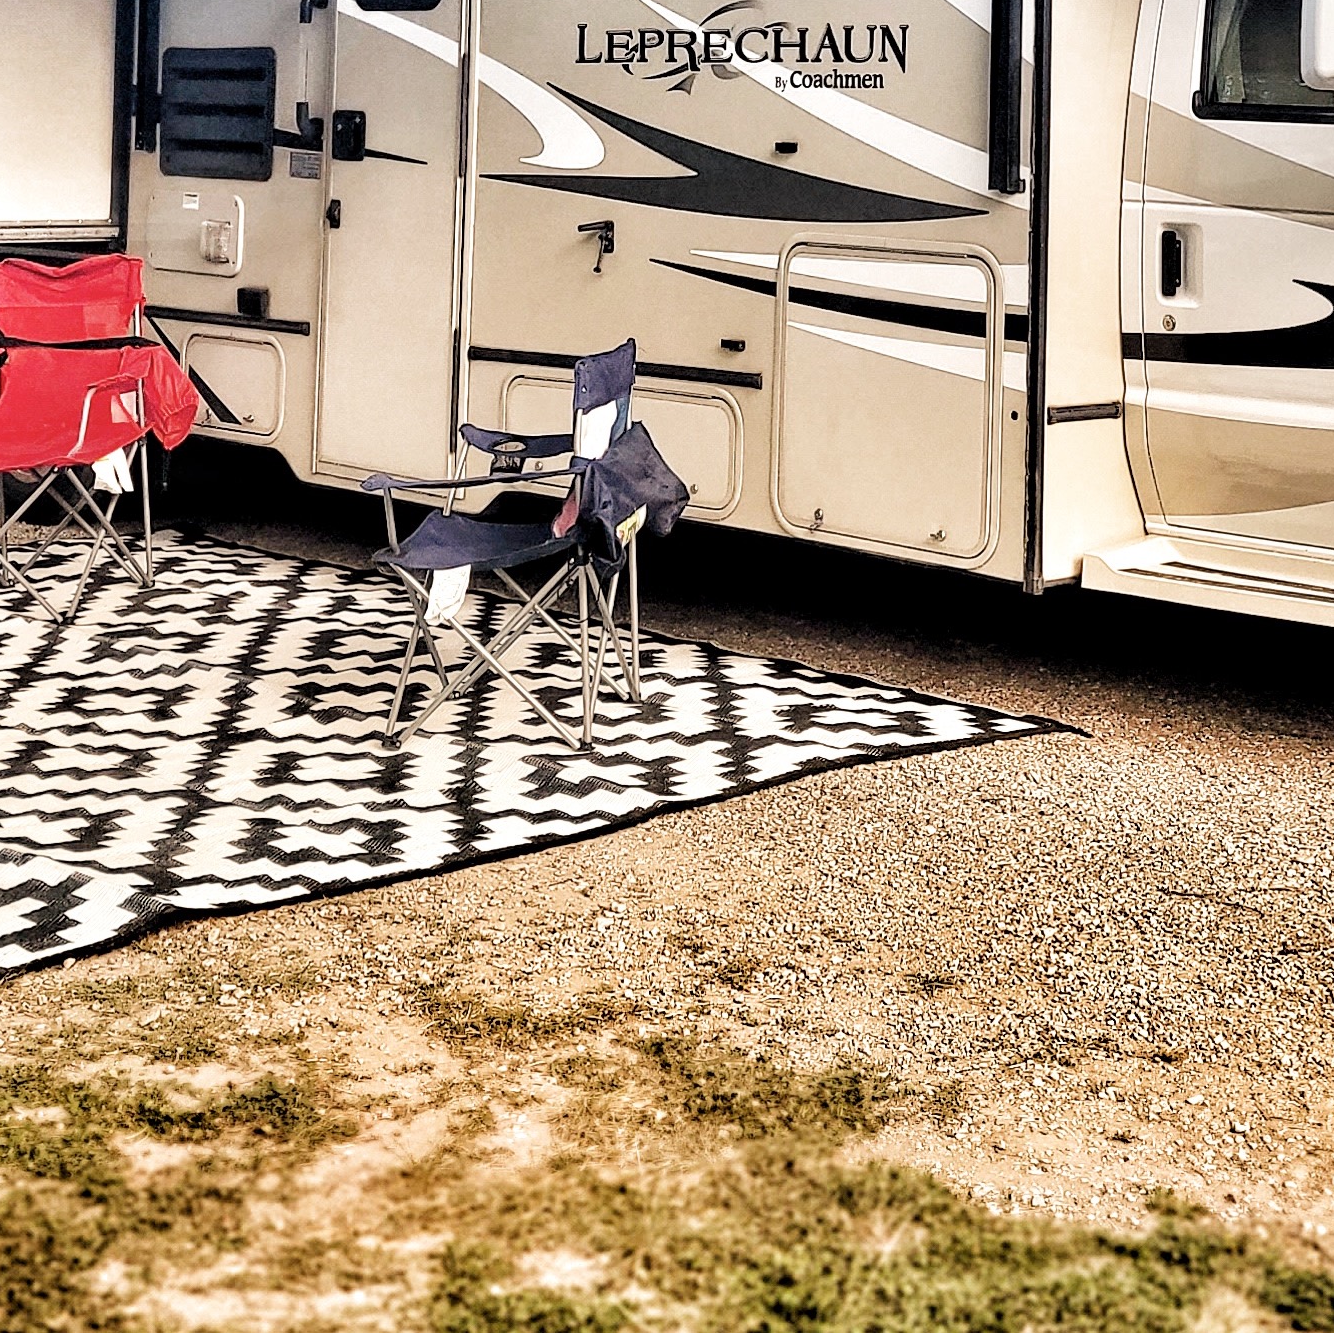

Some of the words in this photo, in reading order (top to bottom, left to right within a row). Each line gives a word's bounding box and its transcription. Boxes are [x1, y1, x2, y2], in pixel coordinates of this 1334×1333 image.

[575, 22, 910, 73] LEPRECHAUN
[775, 76, 788, 92] By
[789, 69, 885, 90] Coachmen
